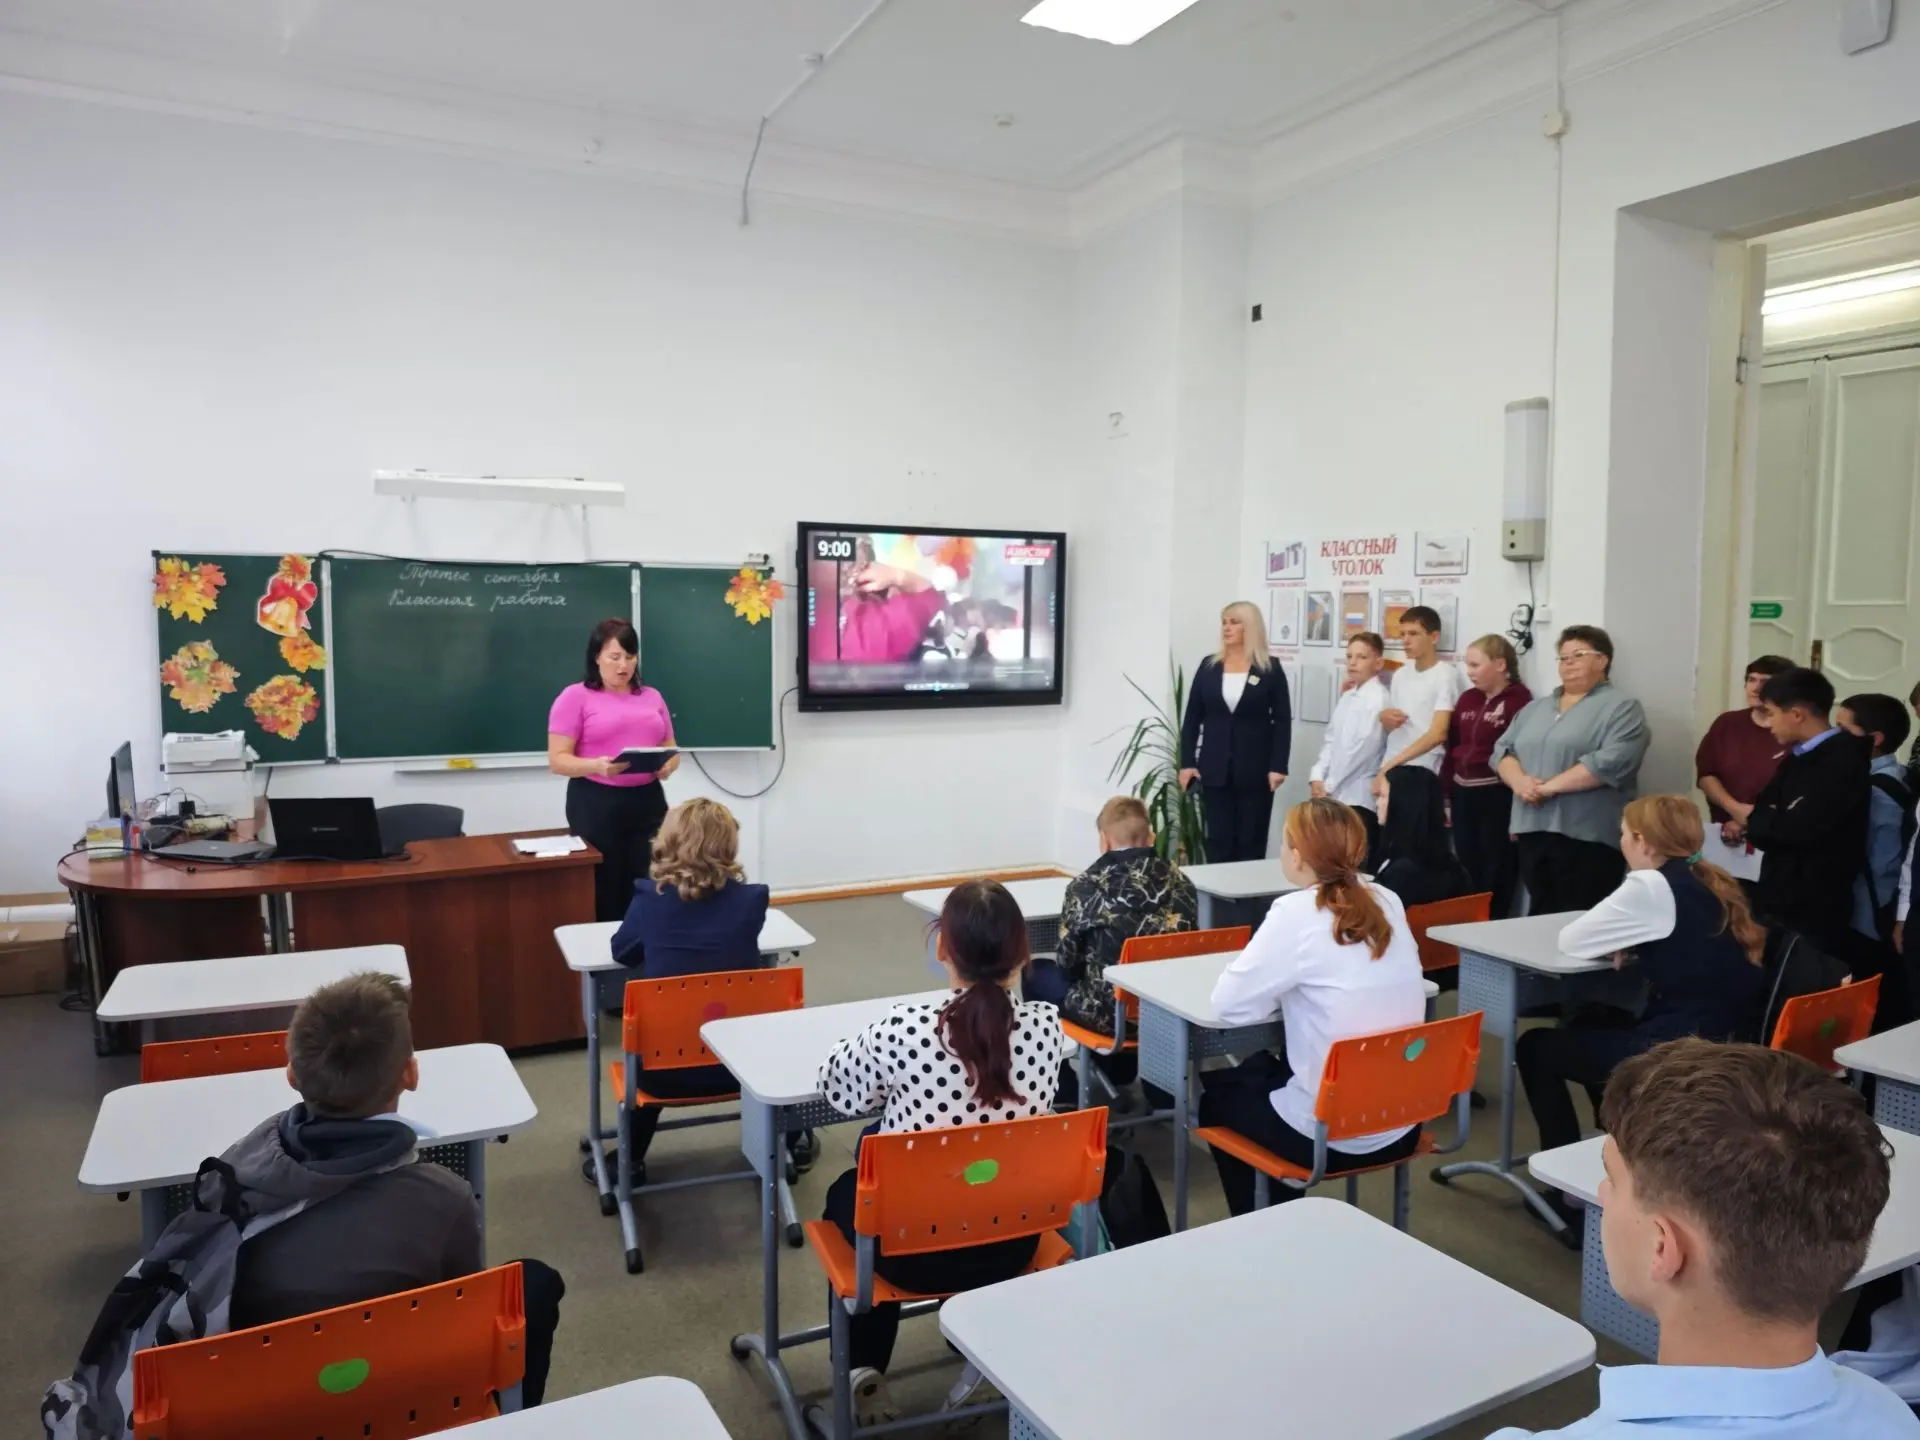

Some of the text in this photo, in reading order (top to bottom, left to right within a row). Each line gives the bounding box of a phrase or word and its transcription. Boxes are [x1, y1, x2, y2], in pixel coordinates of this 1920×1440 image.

[817, 540, 851, 557] 9:00
[1320, 534, 1397, 557] КЛАССНЫЙ
[1331, 558, 1384, 576] УГОЛОК
[389, 588, 567, 612] Классная работа
